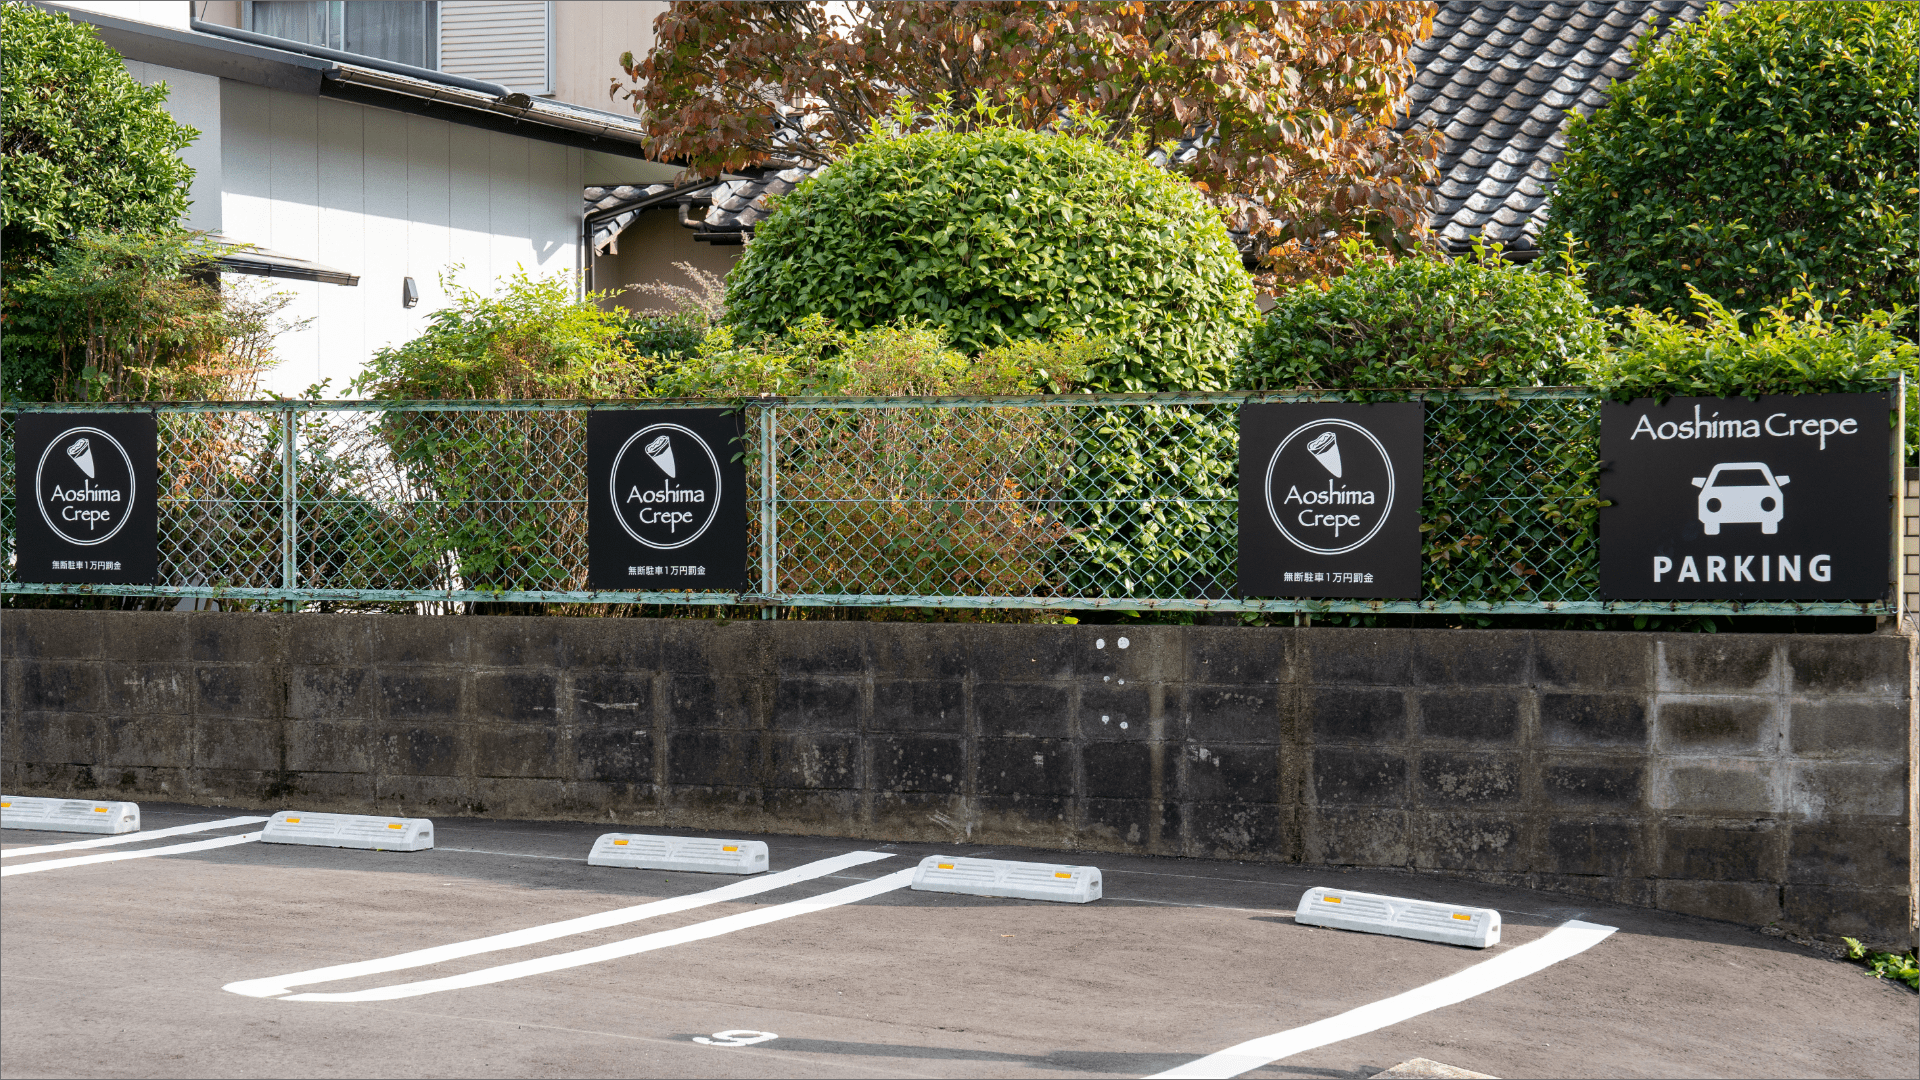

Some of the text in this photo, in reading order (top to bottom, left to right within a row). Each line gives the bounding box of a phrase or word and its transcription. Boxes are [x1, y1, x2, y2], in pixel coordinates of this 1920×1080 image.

[1630, 404, 1858, 450] Aoshima Crepe
[51, 478, 121, 502] Aoshima
[626, 478, 705, 503] Aoshima
[1283, 478, 1375, 505] Aoshima
[61, 505, 111, 531] Crepe
[639, 507, 692, 534] Crepe
[1297, 510, 1361, 538] Crepe
[51, 560, 122, 571] 無断駐車1万円罰金
[628, 565, 706, 576] 無断駐車1万円罰金
[1283, 571, 1374, 584] 無断駐車1万円罰金
[1653, 555, 1831, 583] PARKING
